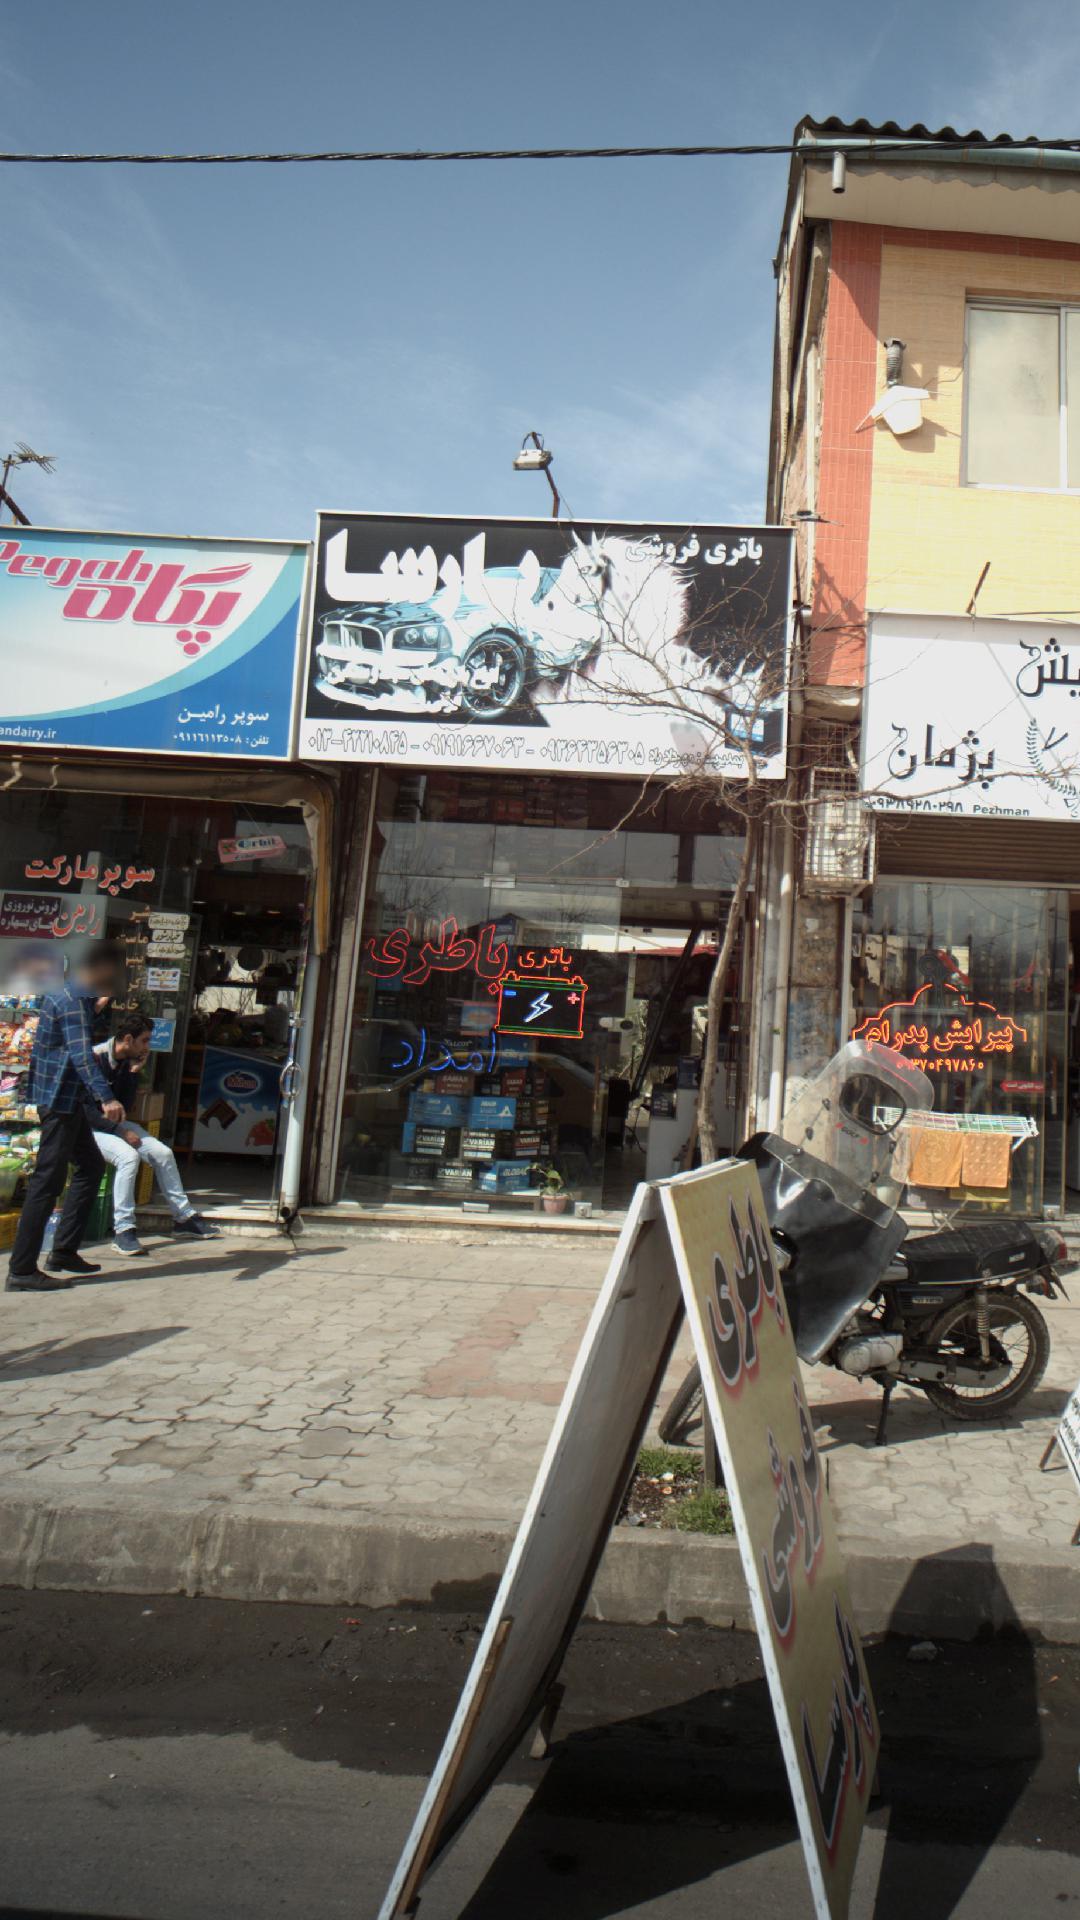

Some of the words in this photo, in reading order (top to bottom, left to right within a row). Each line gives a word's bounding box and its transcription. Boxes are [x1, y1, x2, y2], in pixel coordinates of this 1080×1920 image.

[626, 533, 700, 563] فروشی
[705, 536, 763, 566] باتری
[62, 562, 252, 656] پگاه
[178, 704, 227, 725] رامین
[230, 711, 270, 726] سوپر
[888, 721, 996, 790] پژمان
[972, 804, 1030, 817] Pezhman
[25, 854, 98, 885] مارکت
[99, 866, 155, 896] سوپر
[3, 900, 34, 913] نوروزی
[33, 901, 60, 915] فروش
[365, 916, 509, 996] باطری
[518, 947, 573, 972] باتری
[392, 1027, 497, 1073] امداد
[933, 1018, 1014, 1053] پیرایش
[706, 1191, 785, 1388] باطری
[762, 1374, 822, 1639] فروشی
[801, 1590, 874, 1849] پارسا
